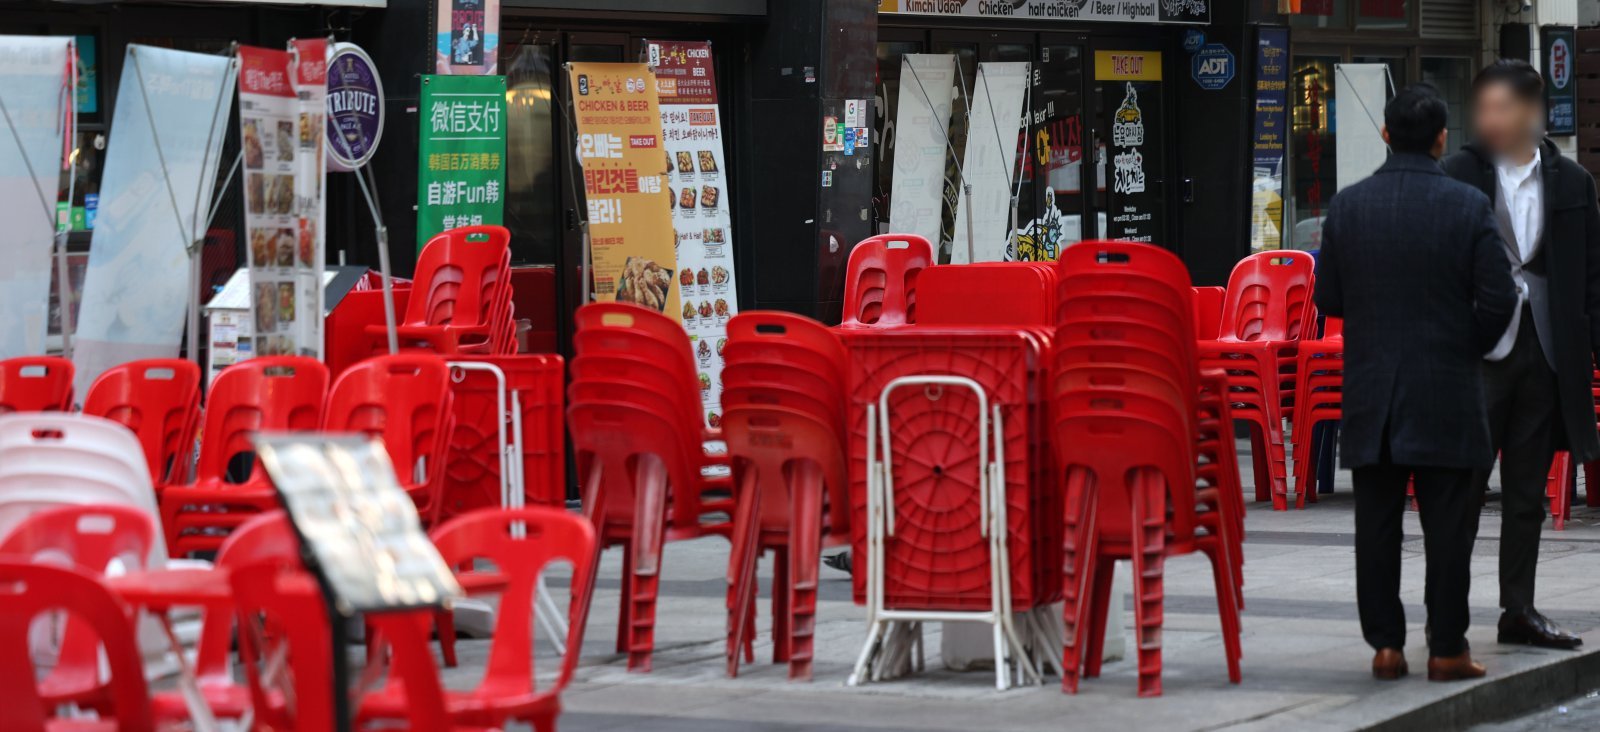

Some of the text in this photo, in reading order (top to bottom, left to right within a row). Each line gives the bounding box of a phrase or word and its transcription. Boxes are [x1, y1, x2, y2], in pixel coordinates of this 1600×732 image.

[905, 0, 961, 14] Kimchi Udon
[979, 2, 1013, 16] Chicken
[1028, 4, 1045, 17] half
[1047, 4, 1079, 18] chicken
[1096, 3, 1115, 16] Beer
[1122, 3, 1155, 20] Highball
[687, 48, 709, 58] CHICKEN
[692, 67, 706, 77] BEER
[1111, 55, 1144, 75] TAKE OUT
[1198, 57, 1228, 75] ADT
[326, 90, 377, 115] TRIBUTE
[579, 101, 649, 111] CHICKEN & BEER
[430, 100, 501, 133] 微信支付
[690, 112, 702, 122] TAKE
[703, 112, 714, 122] OUT
[580, 133, 655, 158] 오빠는 TAKE OUT
[428, 152, 501, 171] 韩国百万消费券
[427, 179, 500, 206] 自游Fun韩
